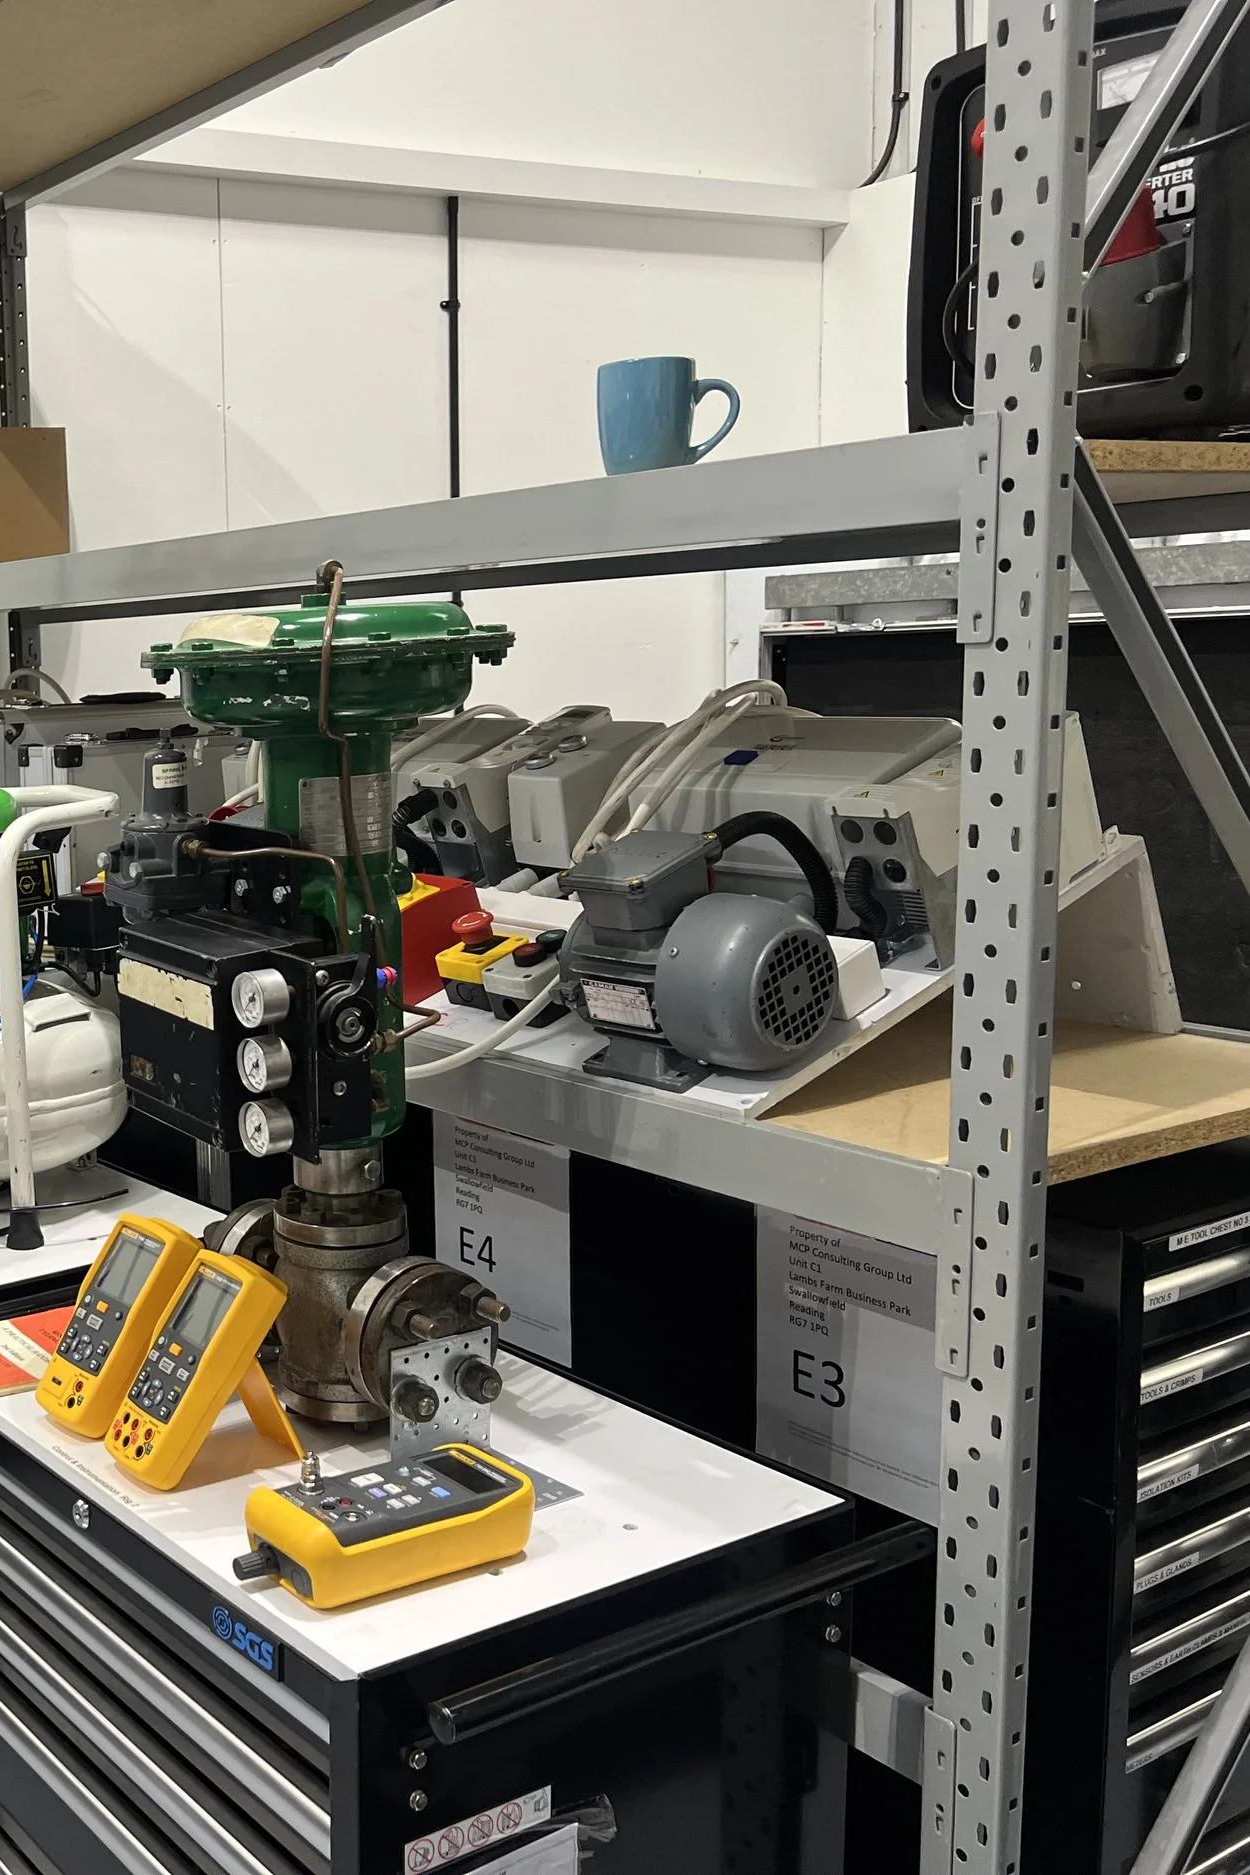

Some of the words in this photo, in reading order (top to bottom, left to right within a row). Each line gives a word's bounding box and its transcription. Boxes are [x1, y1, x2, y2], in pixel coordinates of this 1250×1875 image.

[454, 1126, 480, 1141] Property
[482, 1134, 489, 1142] of
[455, 1138, 469, 1149] MCP
[470, 1143, 502, 1160] Consulting
[503, 1152, 523, 1166] Group
[524, 1159, 535, 1168] Ltd
[455, 1151, 467, 1161] Unit
[468, 1155, 477, 1163] C1
[455, 1163, 474, 1174] Lambs
[476, 1168, 492, 1179] Farm
[493, 1174, 519, 1189] Business
[520, 1183, 535, 1193] Park
[455, 1174, 493, 1193] Swallowfield
[456, 1186, 480, 1202] Reading
[456, 1198, 469, 1209] RG7
[470, 1202, 483, 1215] 1PQ
[790, 1226, 829, 1246] Property
[831, 1238, 841, 1248] of
[1191, 1229, 1208, 1241] TOOL
[1210, 1221, 1232, 1235] CHEST
[1233, 1218, 1243, 1227] NO
[460, 1226, 496, 1273] E4
[789, 1256, 807, 1269] Unit
[810, 1262, 821, 1273] C1
[790, 1240, 810, 1253] MCP
[812, 1248, 861, 1271] Consulting
[863, 1262, 893, 1280] Group
[896, 1271, 912, 1284] Ltd
[789, 1271, 817, 1287] Lambs
[820, 1280, 843, 1295] Farm
[846, 1288, 886, 1308] Business
[889, 1301, 911, 1316] Park
[789, 1285, 846, 1311] Swallowfield
[1149, 1292, 1172, 1306] TOOLS
[789, 1301, 825, 1321] Reading
[789, 1315, 807, 1328] RG7
[810, 1321, 829, 1337] 1PQ
[793, 1349, 846, 1408] E3
[1141, 1386, 1163, 1401] TOOLS
[1164, 1384, 1169, 1393] &
[1171, 1374, 1196, 1390] CRIMPS
[1140, 1478, 1175, 1499] ISOLATION
[1177, 1470, 1192, 1483] KITS
[1136, 1574, 1158, 1591] PLUGS
[1165, 1558, 1192, 1577] GLANDS
[232, 1622, 274, 1671] SGS
[1131, 1660, 1163, 1682] SENSORS
